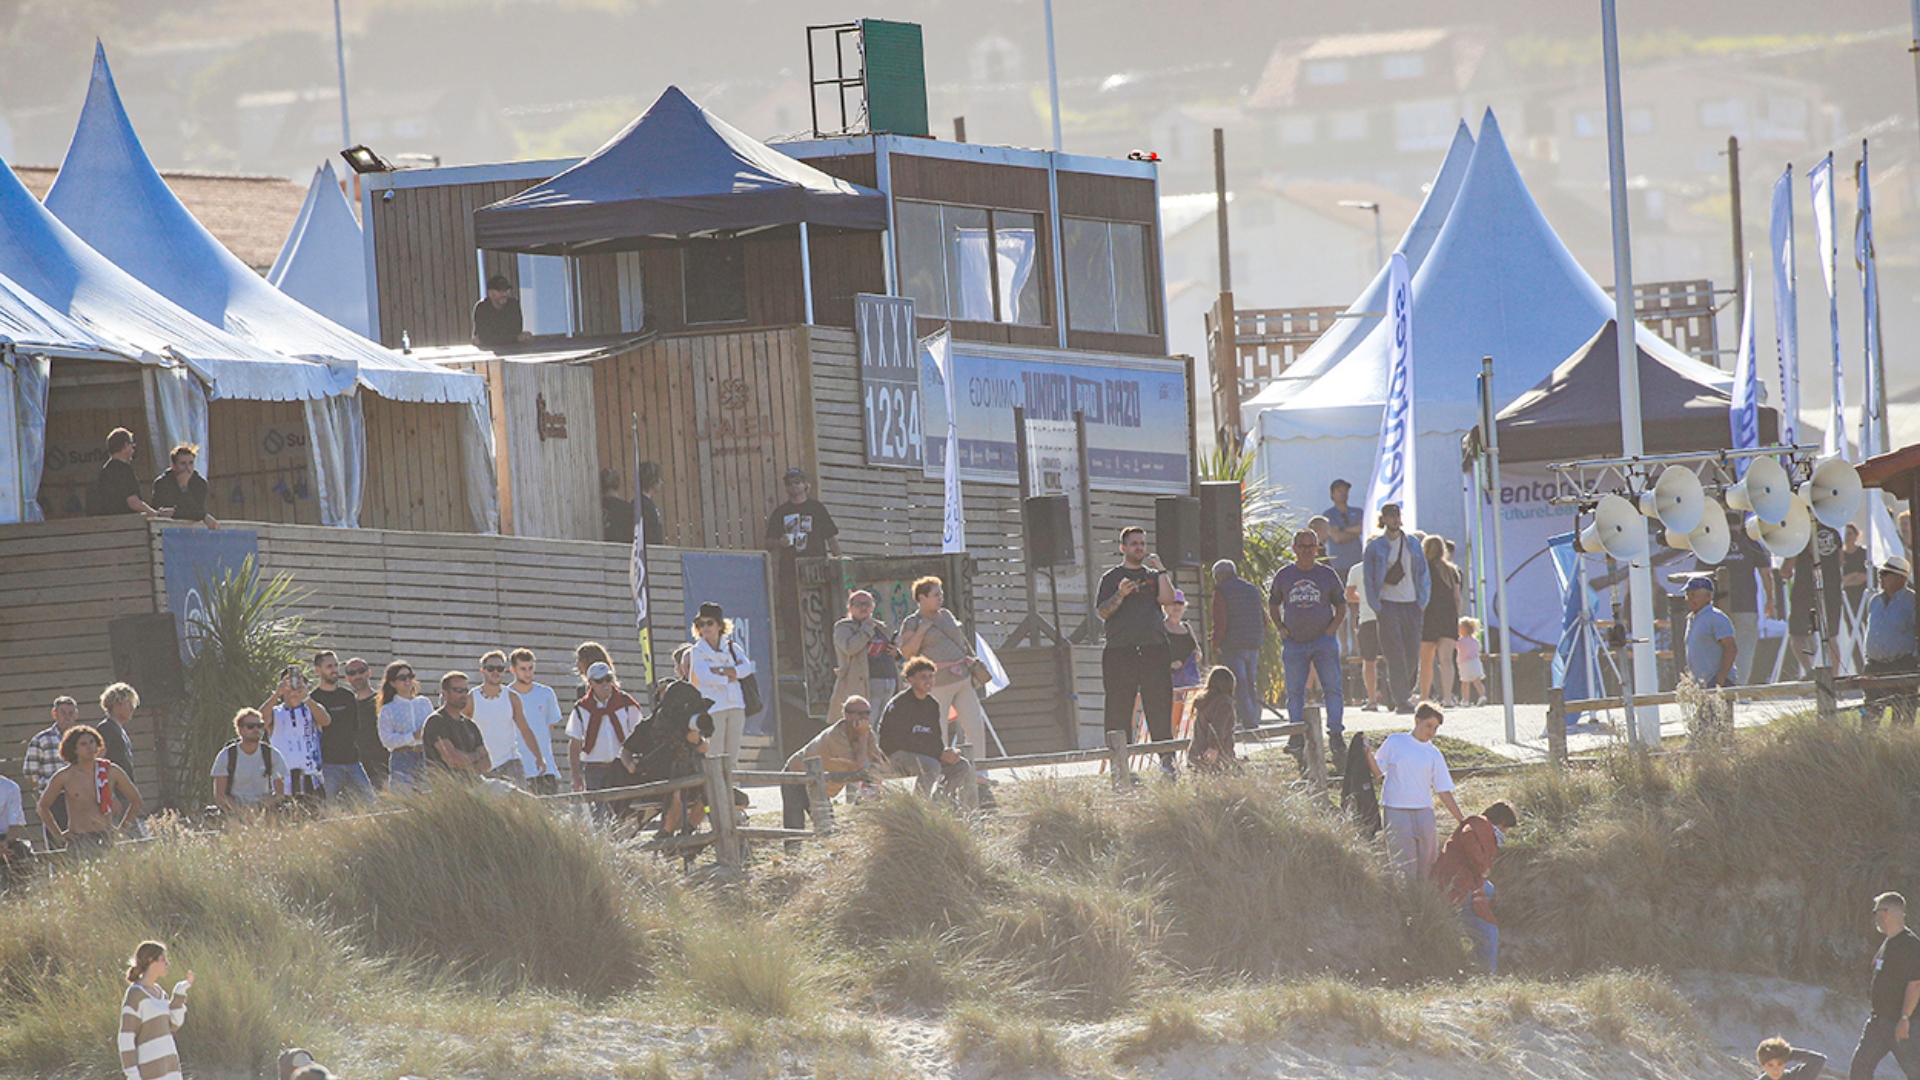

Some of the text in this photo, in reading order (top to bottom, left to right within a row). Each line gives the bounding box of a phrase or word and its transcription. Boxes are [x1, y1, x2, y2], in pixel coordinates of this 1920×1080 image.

[865, 386, 921, 461] 1234
[1021, 371, 1069, 421] JUNIOR
[1105, 378, 1141, 428] RAZO
[694, 415, 780, 442] JAEL
